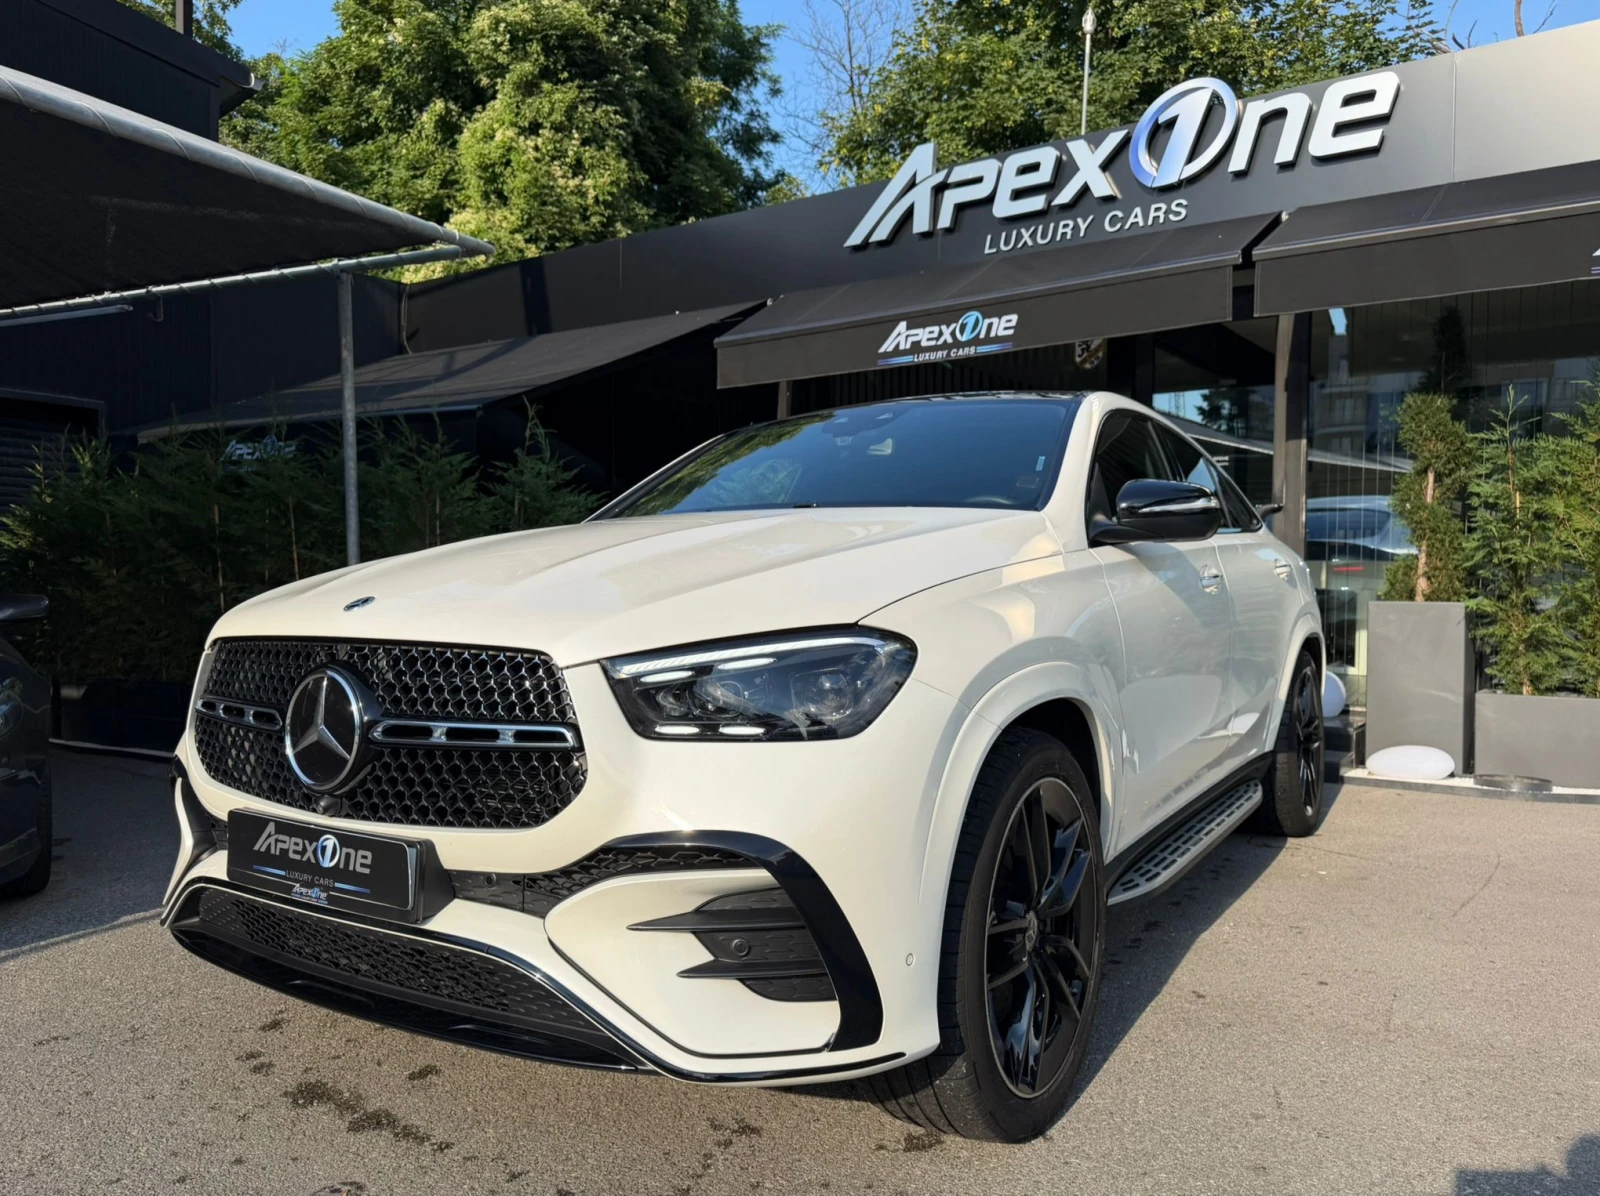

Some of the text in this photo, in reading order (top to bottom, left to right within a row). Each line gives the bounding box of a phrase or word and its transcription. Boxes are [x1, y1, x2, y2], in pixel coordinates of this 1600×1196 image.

[983, 198, 1189, 255] LUXURY CARS
[914, 346, 976, 362] LUXURY CARS
[286, 870, 334, 888] LUXURY CARS
